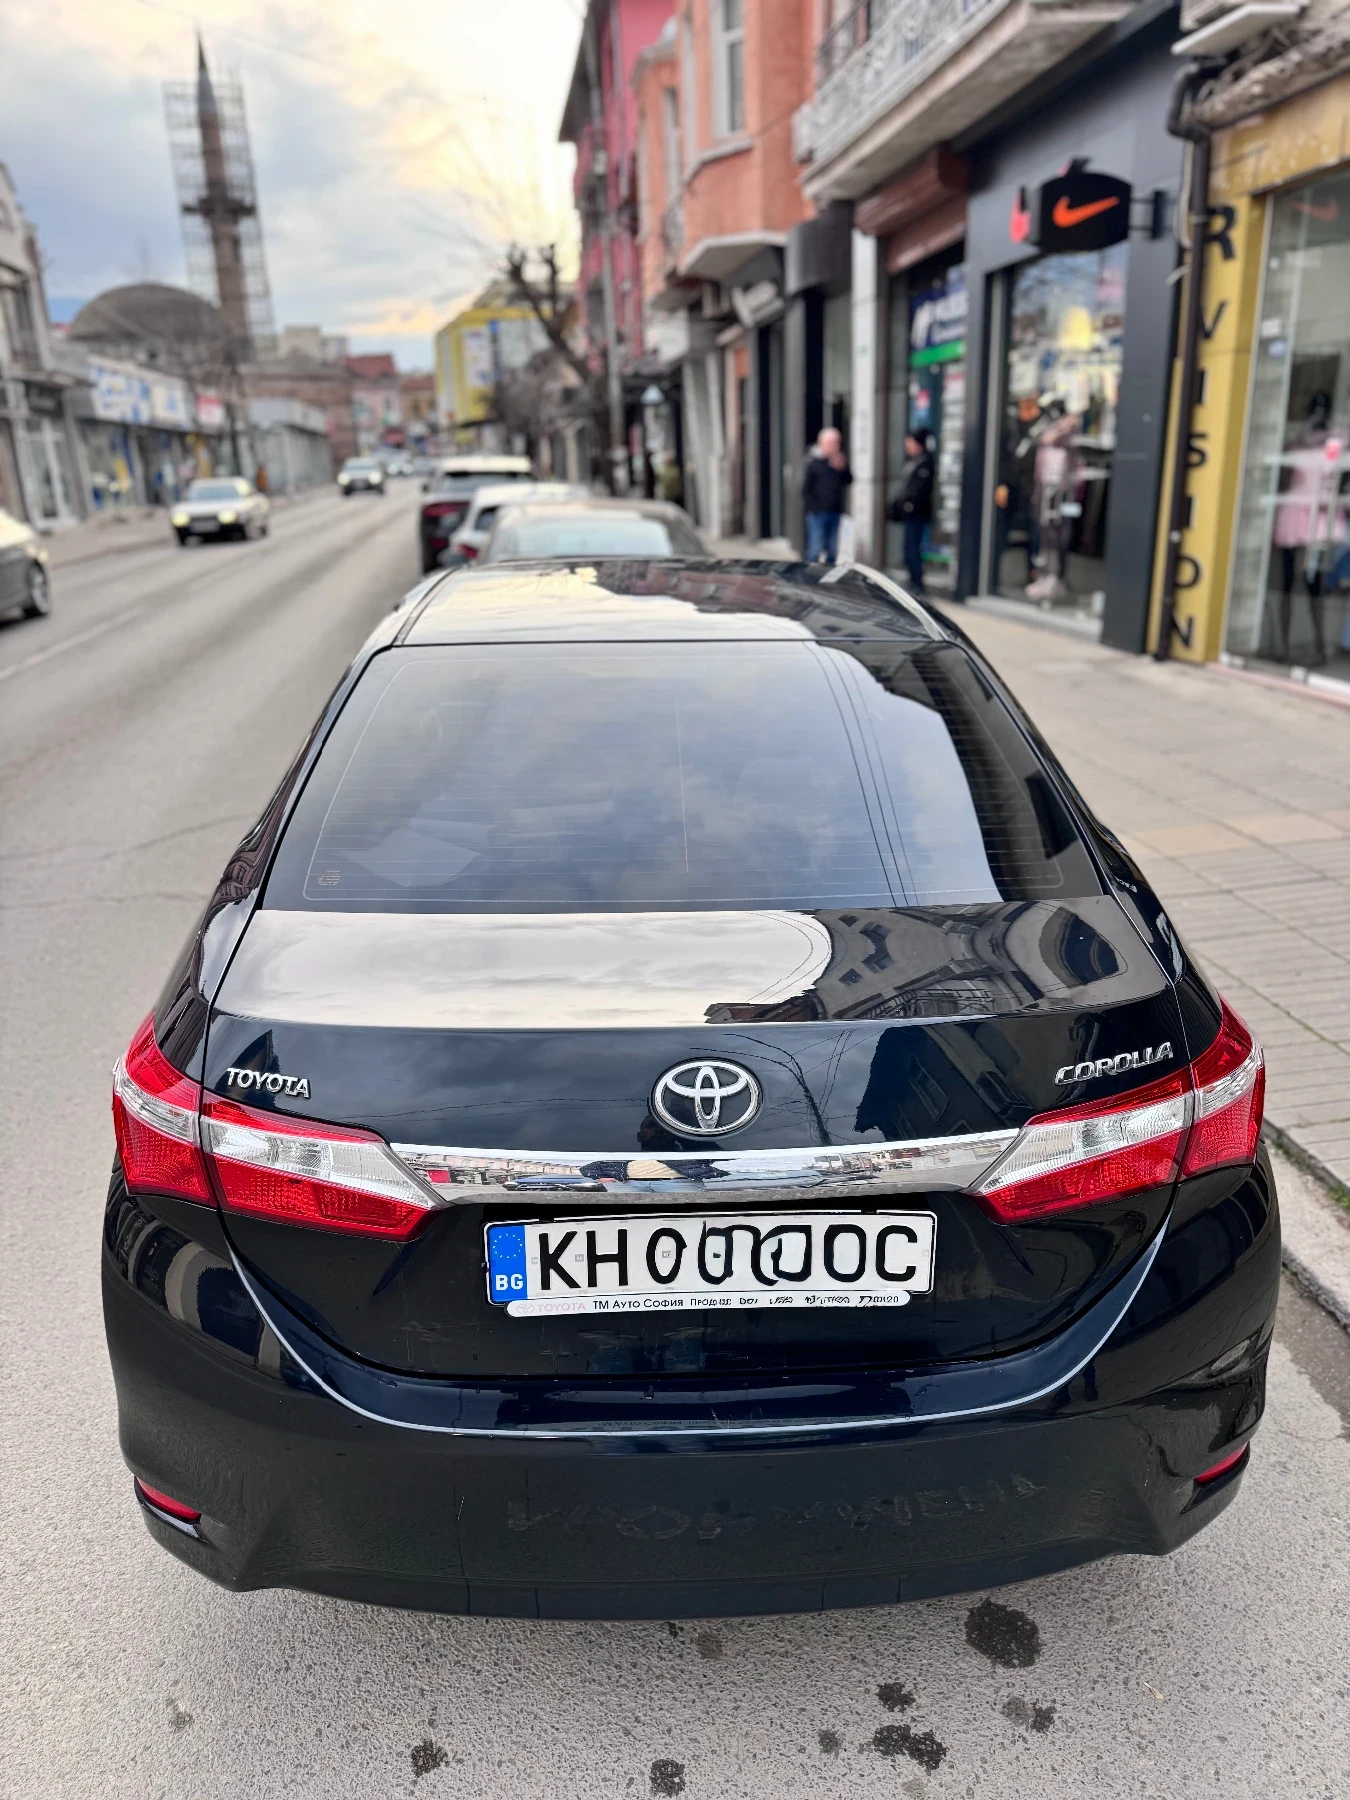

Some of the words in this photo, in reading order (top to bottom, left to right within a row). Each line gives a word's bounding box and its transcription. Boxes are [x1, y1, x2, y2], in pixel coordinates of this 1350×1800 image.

[1054, 1041, 1174, 1085] COROLLA
[226, 1067, 311, 1099] TOYOTA
[495, 1274, 524, 1291] BG
[537, 1302, 586, 1314] TOYOTA
[643, 1298, 684, 1308] София
